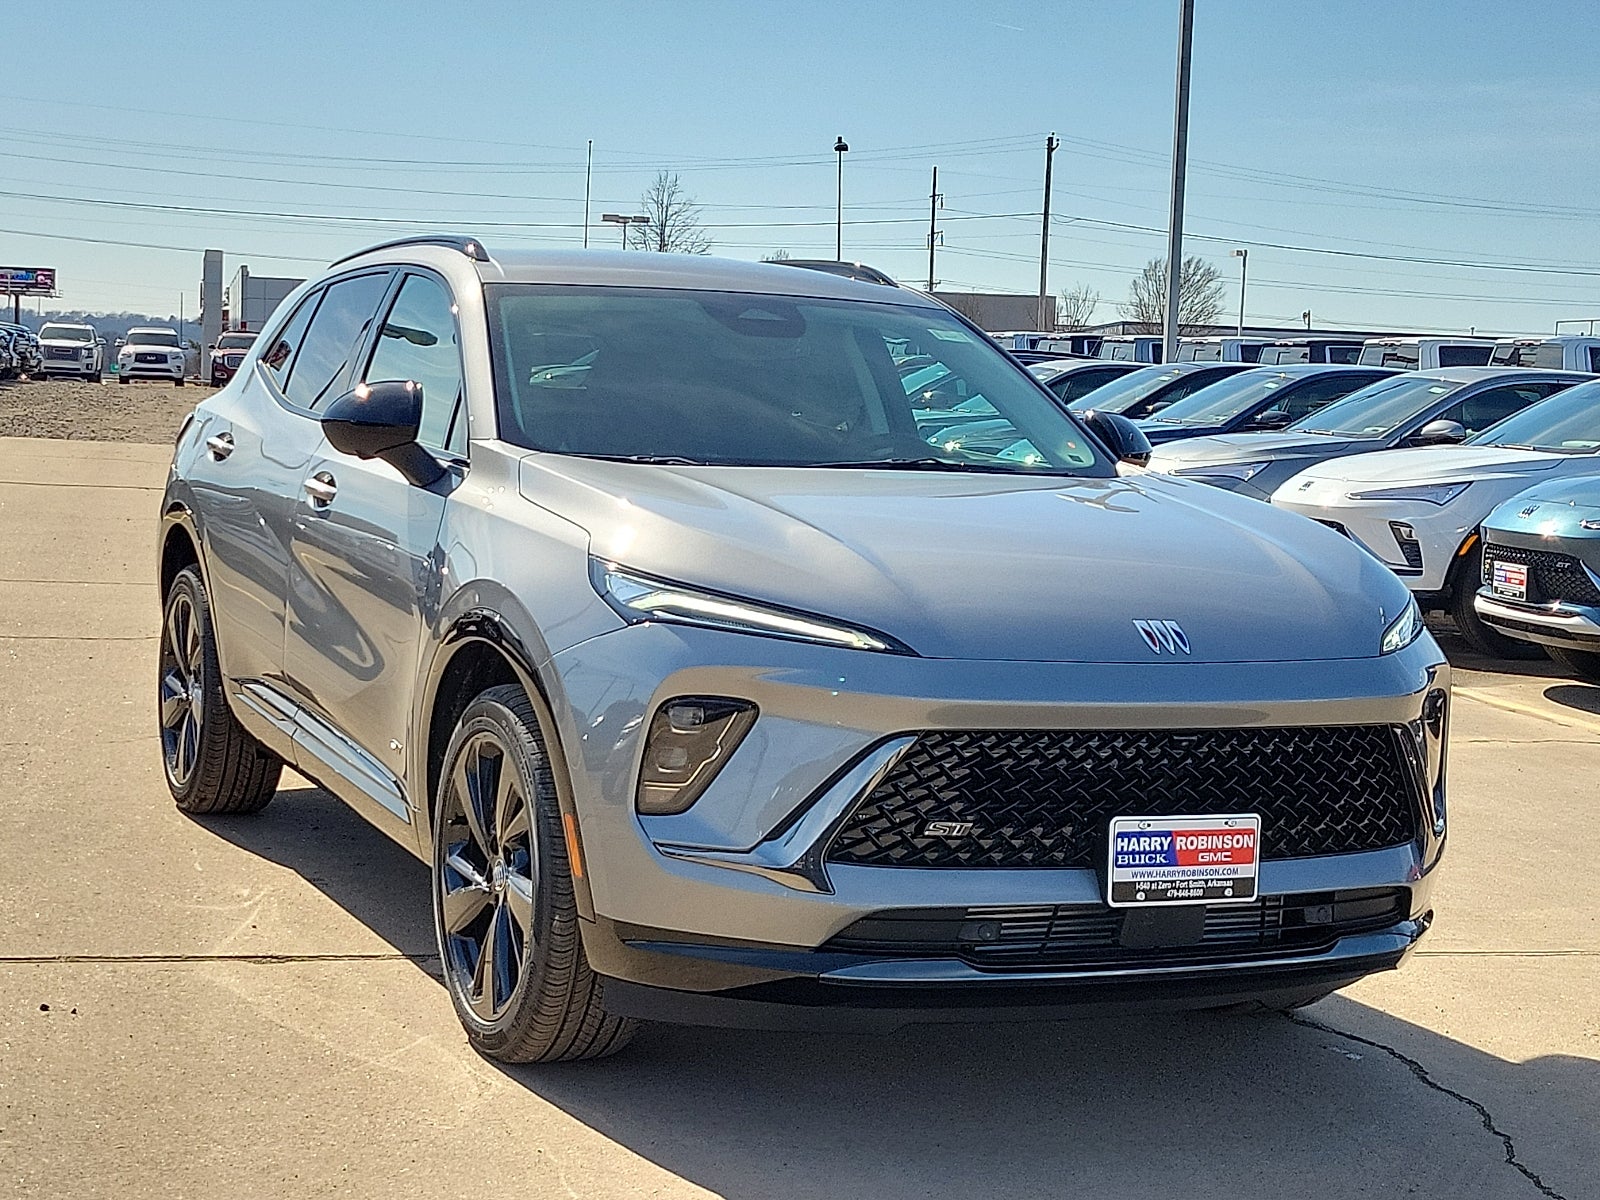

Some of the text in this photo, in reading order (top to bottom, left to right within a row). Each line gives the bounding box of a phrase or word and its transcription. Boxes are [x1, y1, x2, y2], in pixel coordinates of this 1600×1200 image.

[924, 821, 974, 836] ST
[1117, 834, 1254, 852] HARRY ROBINSON
[1117, 853, 1169, 865] BUICK
[1198, 851, 1233, 862] GMC
[1131, 867, 1239, 879] WWW.HARRYROBINSON.COM
[1158, 881, 1172, 889] Zero
[1175, 880, 1188, 888] Fort
